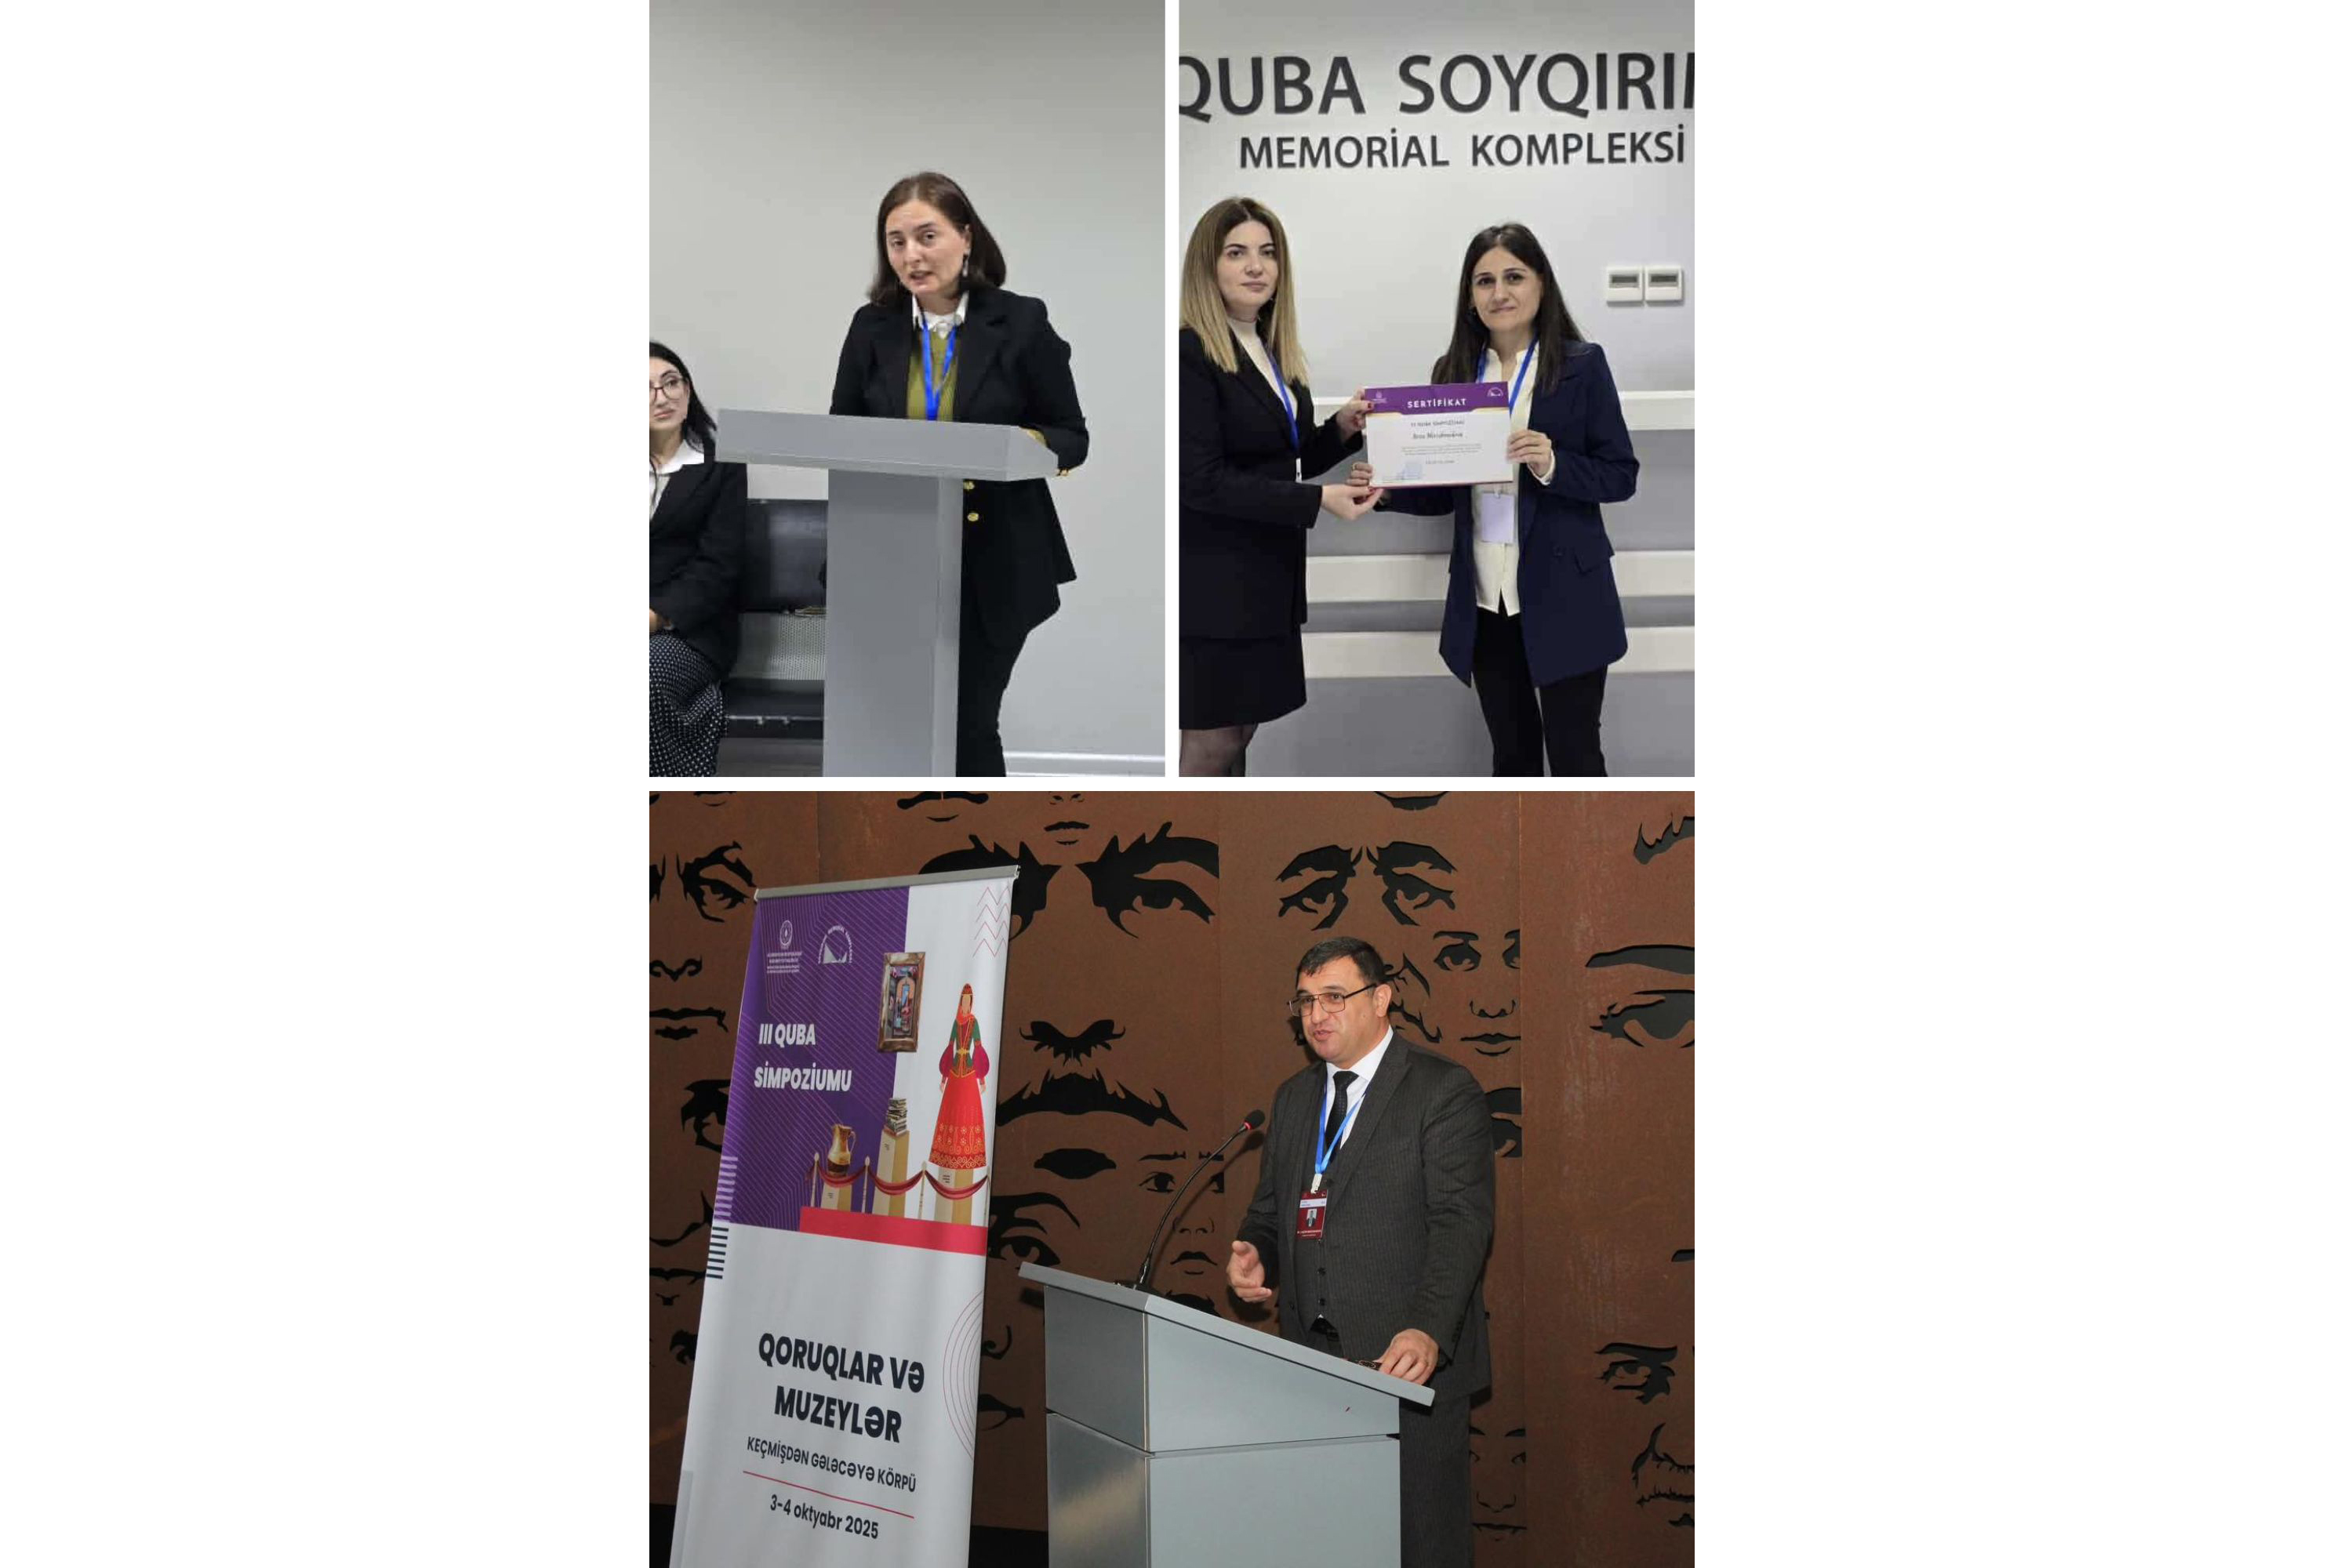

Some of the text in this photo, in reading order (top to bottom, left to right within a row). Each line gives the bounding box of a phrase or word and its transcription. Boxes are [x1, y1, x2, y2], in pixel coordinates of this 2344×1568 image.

[1179, 53, 1695, 123] QUBA SOYQIRI
[1240, 123, 1684, 169] MEMORİAL KOMPLEKSİ
[1407, 397, 1466, 408] SERTİFİKAT
[758, 1023, 816, 1048] III QUBA
[754, 1061, 852, 1092] SİMPOZİUMU
[758, 1332, 925, 1393] QORUQLAR VƏ
[773, 1385, 902, 1443] MUZEYLƏR
[747, 1436, 917, 1493] KEÇMİŞDƏN GƏLƏCƏYƏ KÖRPÜ
[770, 1494, 879, 1540] 3-4 oktyabr 2025
